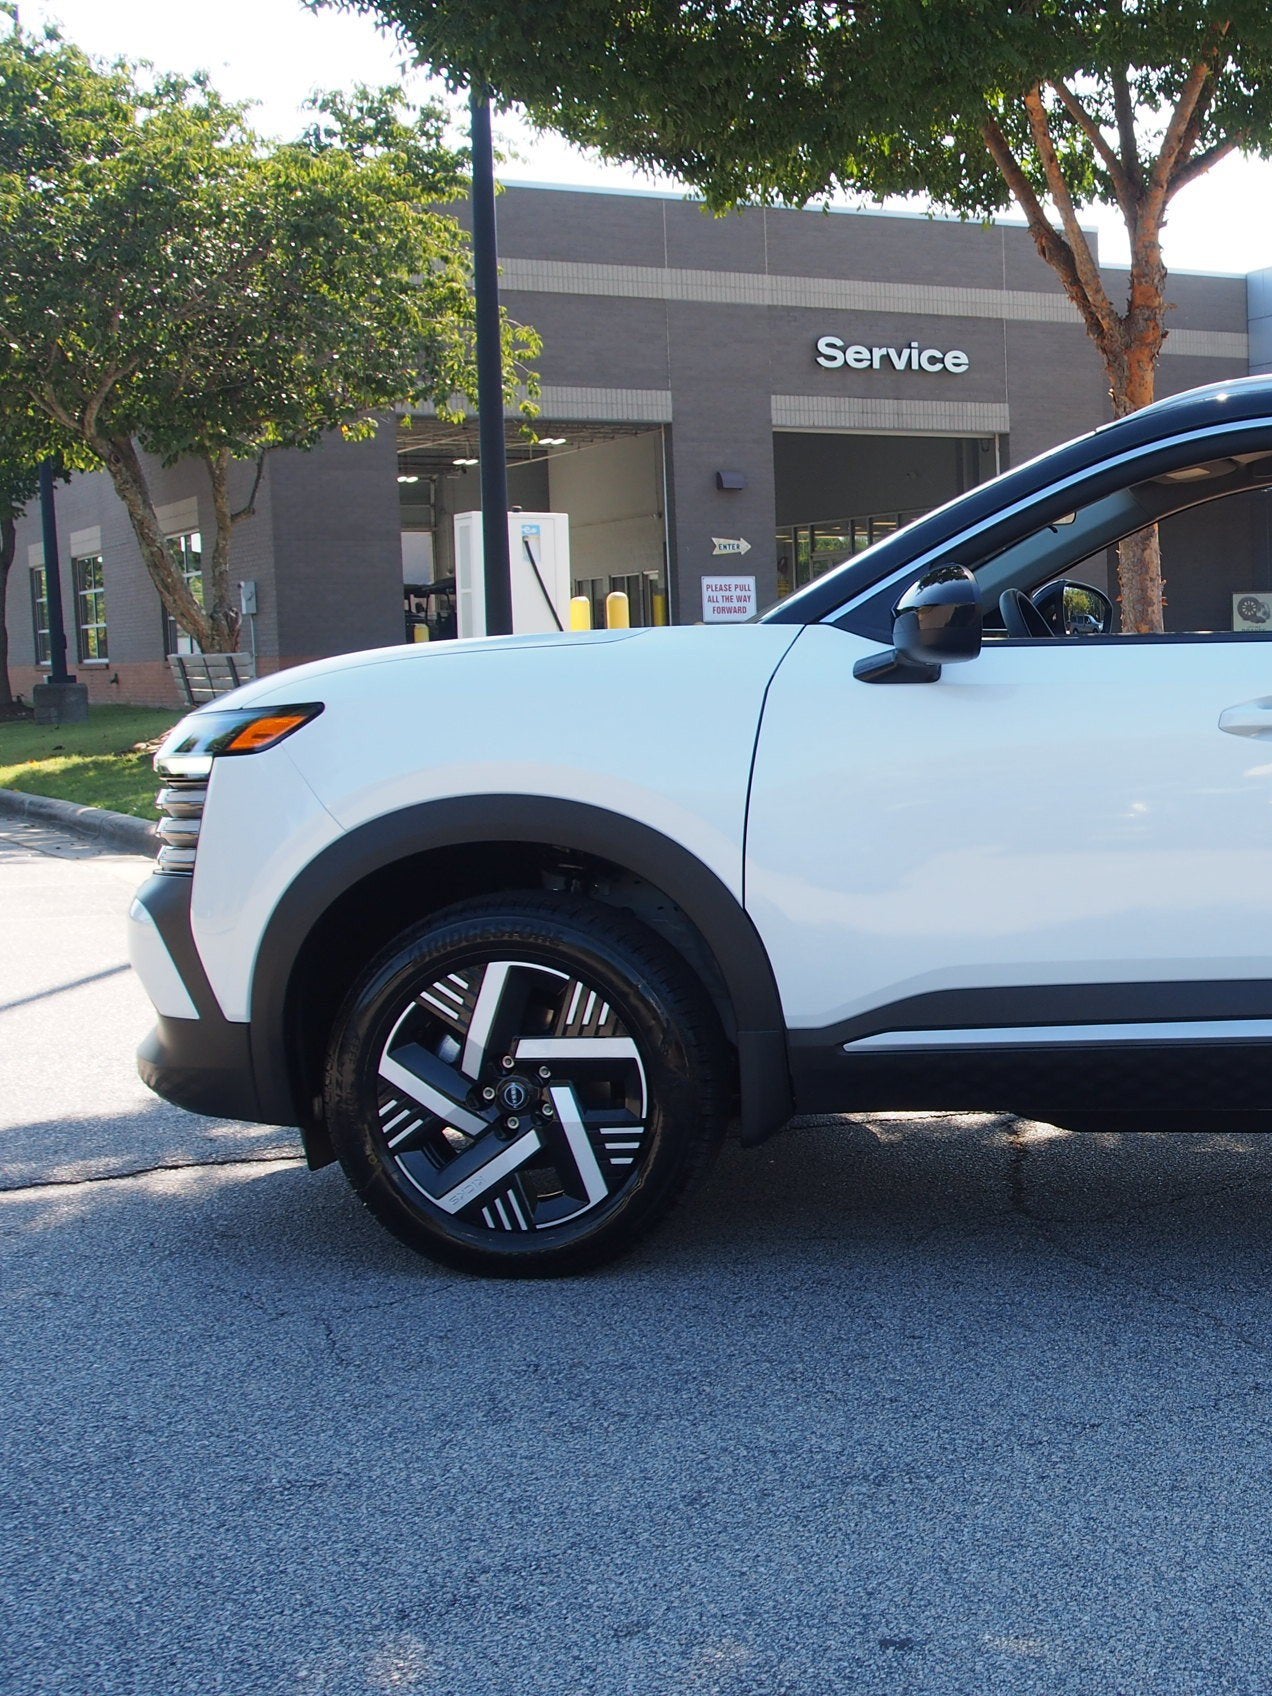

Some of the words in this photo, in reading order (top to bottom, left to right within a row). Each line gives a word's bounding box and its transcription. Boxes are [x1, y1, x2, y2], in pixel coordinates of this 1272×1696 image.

[816, 335, 970, 374] Service
[718, 543, 741, 551] ENTER
[706, 584, 732, 592] PLEASE
[734, 584, 751, 592] PULL
[707, 595, 719, 603] ALL
[722, 595, 734, 603] THE
[736, 595, 751, 603] WAY
[713, 606, 747, 614] FORWARD
